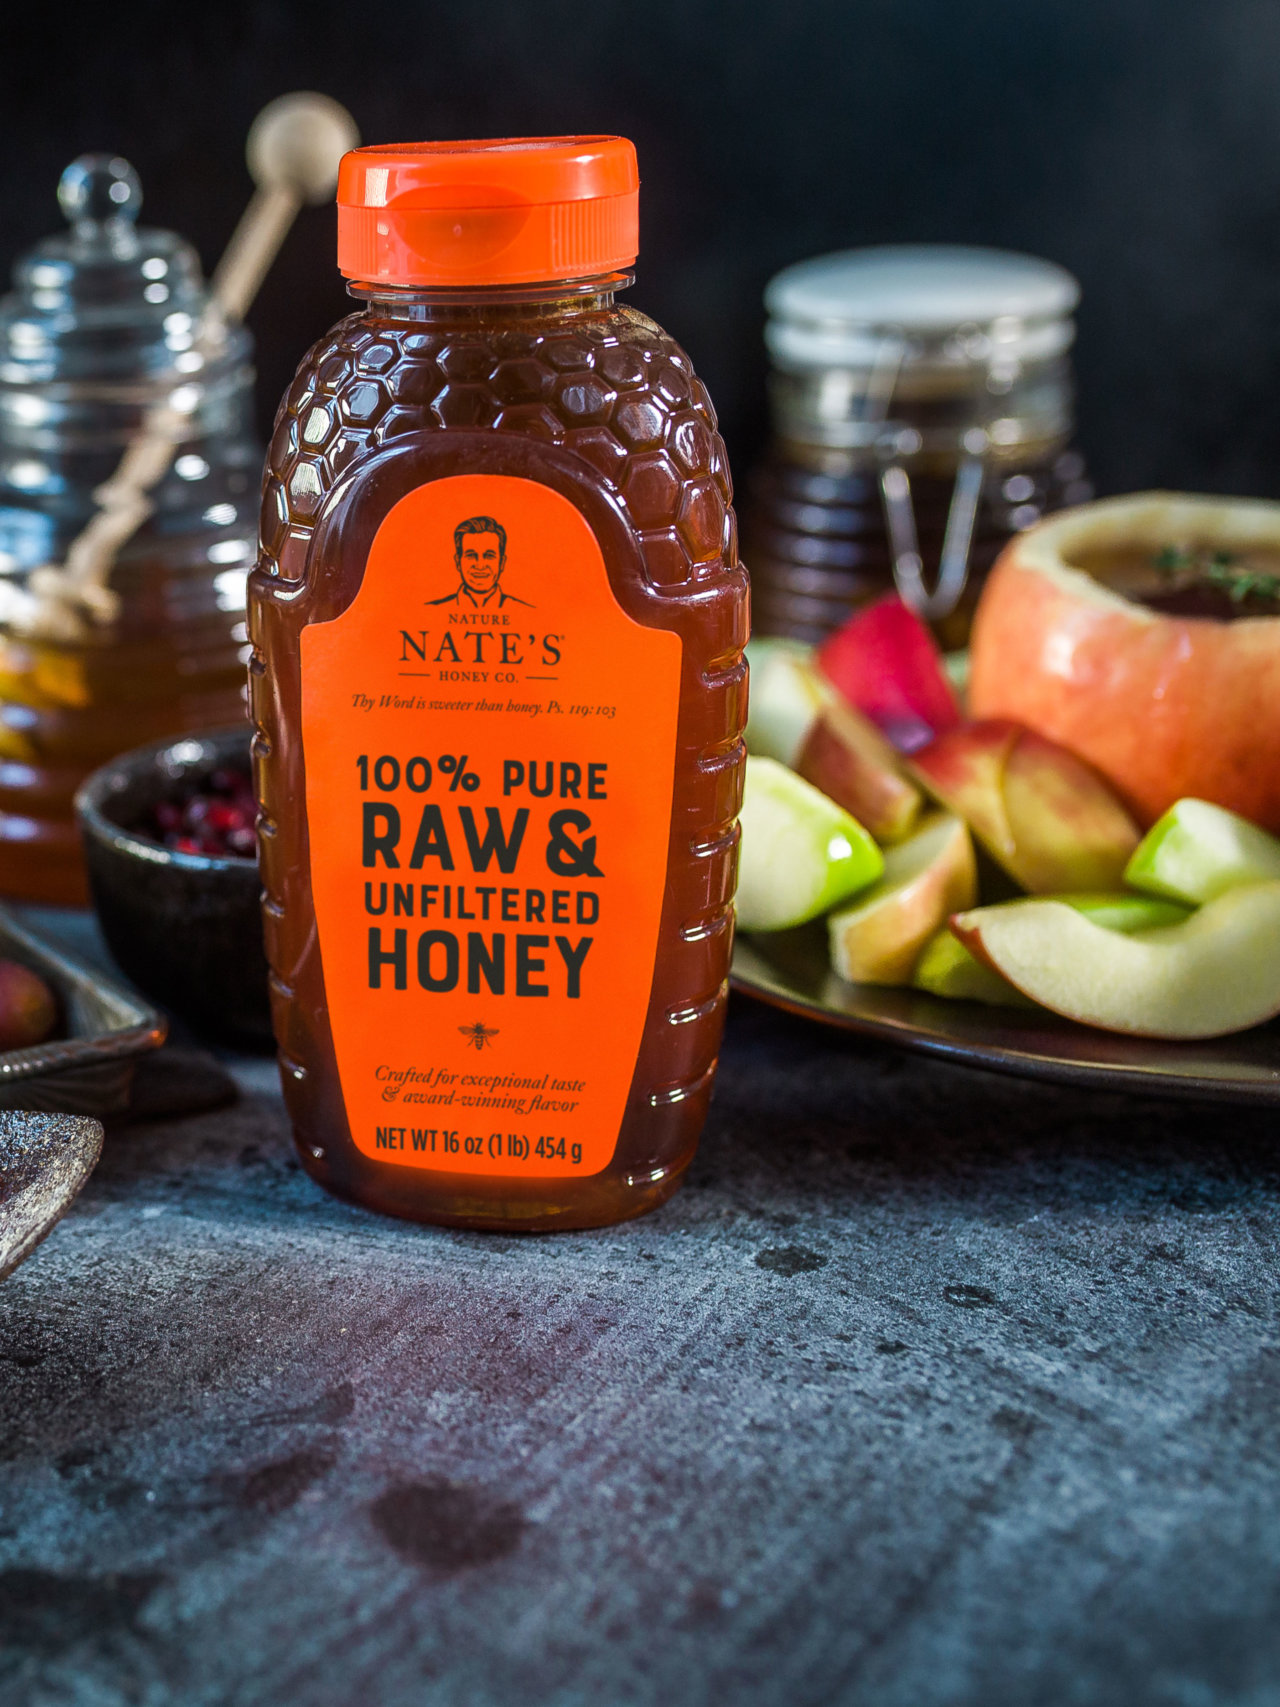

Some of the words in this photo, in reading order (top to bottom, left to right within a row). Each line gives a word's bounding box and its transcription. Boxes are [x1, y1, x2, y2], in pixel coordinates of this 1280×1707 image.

[448, 613, 510, 626] NATURE
[439, 671, 489, 682] HONEY
[495, 672, 519, 683] CO.
[352, 694, 375, 712] Thy
[379, 695, 414, 710] Word
[416, 696, 426, 710] is
[428, 699, 472, 712] sweeter
[475, 698, 503, 713] than
[506, 699, 543, 718] honey.
[547, 701, 564, 715] Ps.
[357, 754, 480, 792] 100%
[504, 760, 608, 799] PURE
[362, 802, 530, 874] RAW
[546, 809, 605, 877] &
[365, 882, 599, 924] UNFILTERED
[368, 927, 593, 998] HONEY
[375, 1065, 432, 1086] Crafted
[433, 1070, 458, 1088] for
[461, 1072, 548, 1092] exceptional
[550, 1078, 586, 1092] taste
[382, 1086, 400, 1102] &
[403, 1090, 526, 1114] award-winning
[527, 1095, 579, 1114] flavor
[376, 1126, 406, 1150] NET
[411, 1129, 438, 1152] WT
[443, 1131, 459, 1153] 16
[465, 1137, 483, 1154] oz
[488, 1134, 502, 1158] (1
[508, 1134, 529, 1160] lb)
[535, 1137, 566, 1159] 454
[572, 1142, 582, 1164] g
